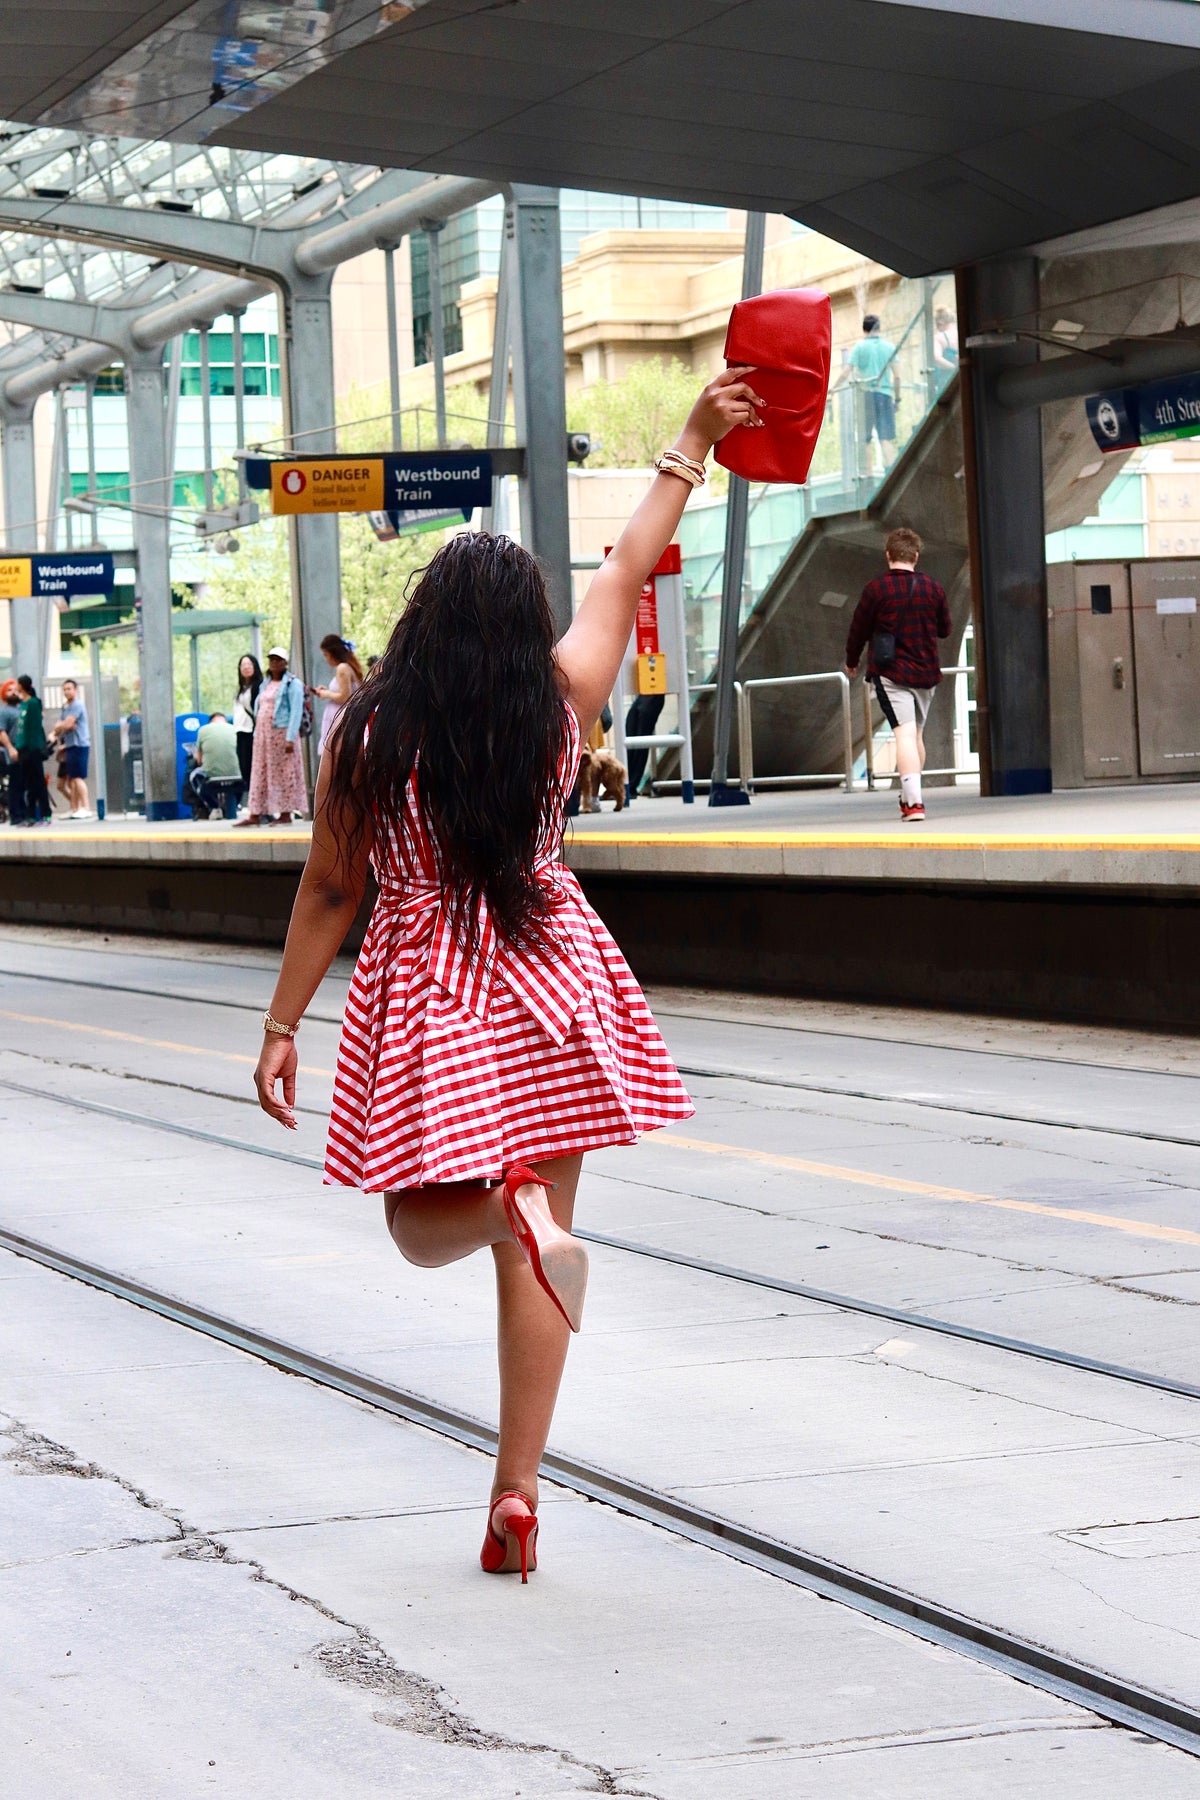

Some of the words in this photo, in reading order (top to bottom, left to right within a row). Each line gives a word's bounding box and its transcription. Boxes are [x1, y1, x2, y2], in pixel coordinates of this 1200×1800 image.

[1155, 398, 1176, 425] 4th
[312, 468, 370, 481] DANGER
[395, 466, 480, 482] Westbound
[395, 487, 432, 501] Train
[38, 563, 104, 577] Westbound
[38, 579, 67, 591] Train
